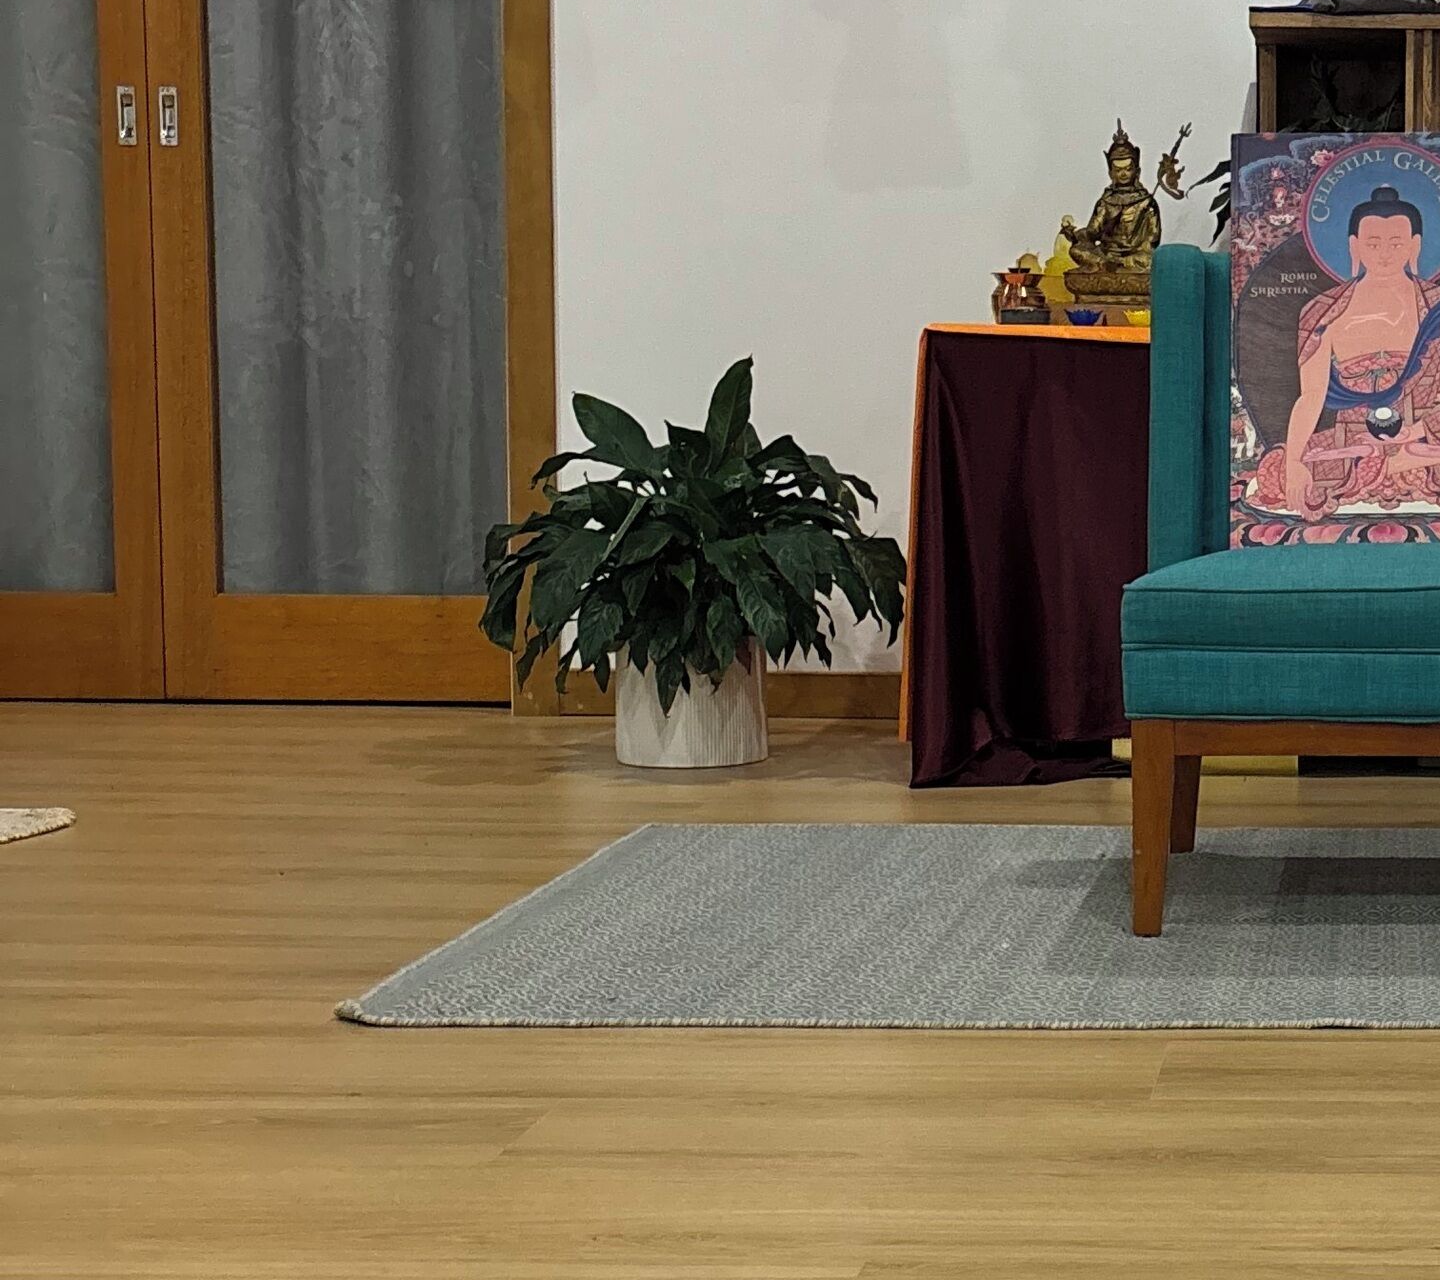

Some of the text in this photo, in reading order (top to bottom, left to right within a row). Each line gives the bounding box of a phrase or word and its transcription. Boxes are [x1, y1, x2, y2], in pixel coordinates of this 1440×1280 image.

[1311, 150, 1386, 223] CELESTIAL
[1280, 272, 1318, 283] ROMIO
[1249, 286, 1309, 298] SHRESTHA
